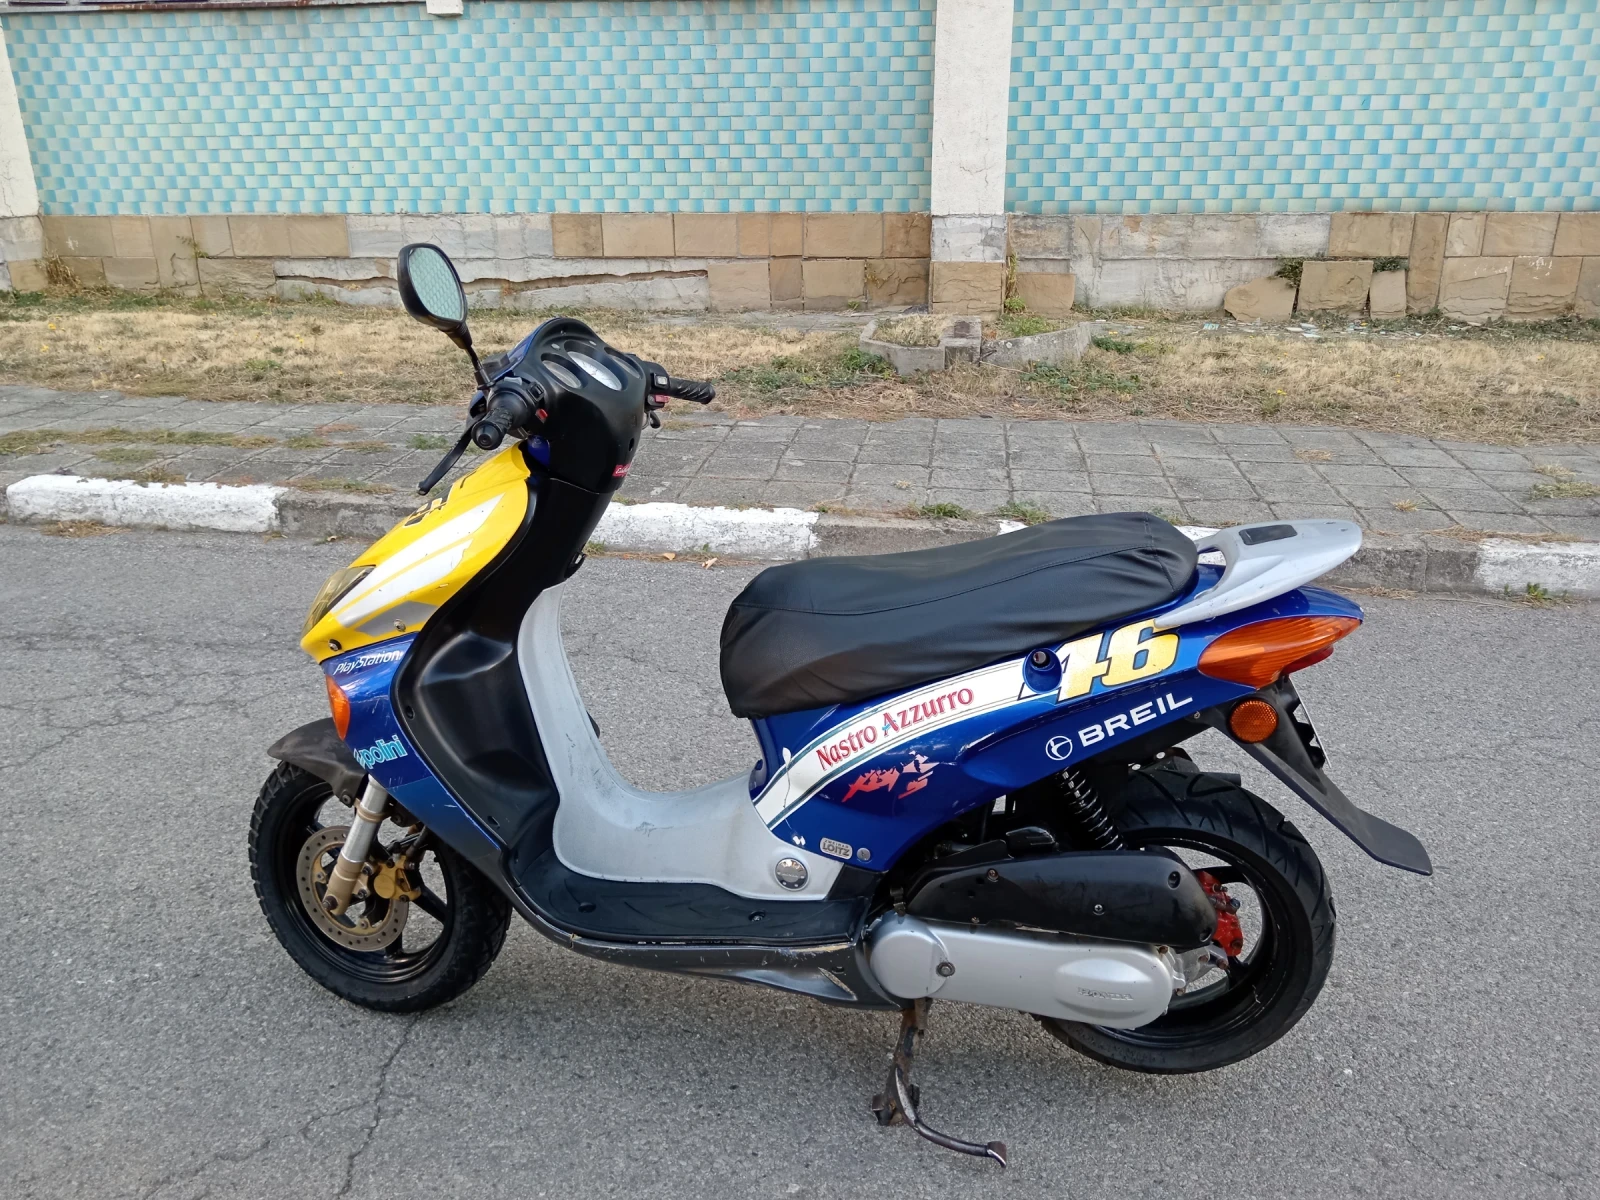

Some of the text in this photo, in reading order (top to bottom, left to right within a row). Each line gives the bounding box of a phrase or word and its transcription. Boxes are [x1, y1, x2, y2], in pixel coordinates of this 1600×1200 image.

[333, 650, 400, 675] PlayStation
[1018, 618, 1181, 704] 46
[816, 688, 974, 771] Nastro Azzurro
[1078, 693, 1193, 747] BREIL
[359, 735, 408, 769] polini
[822, 843, 850, 857] LOITZ
